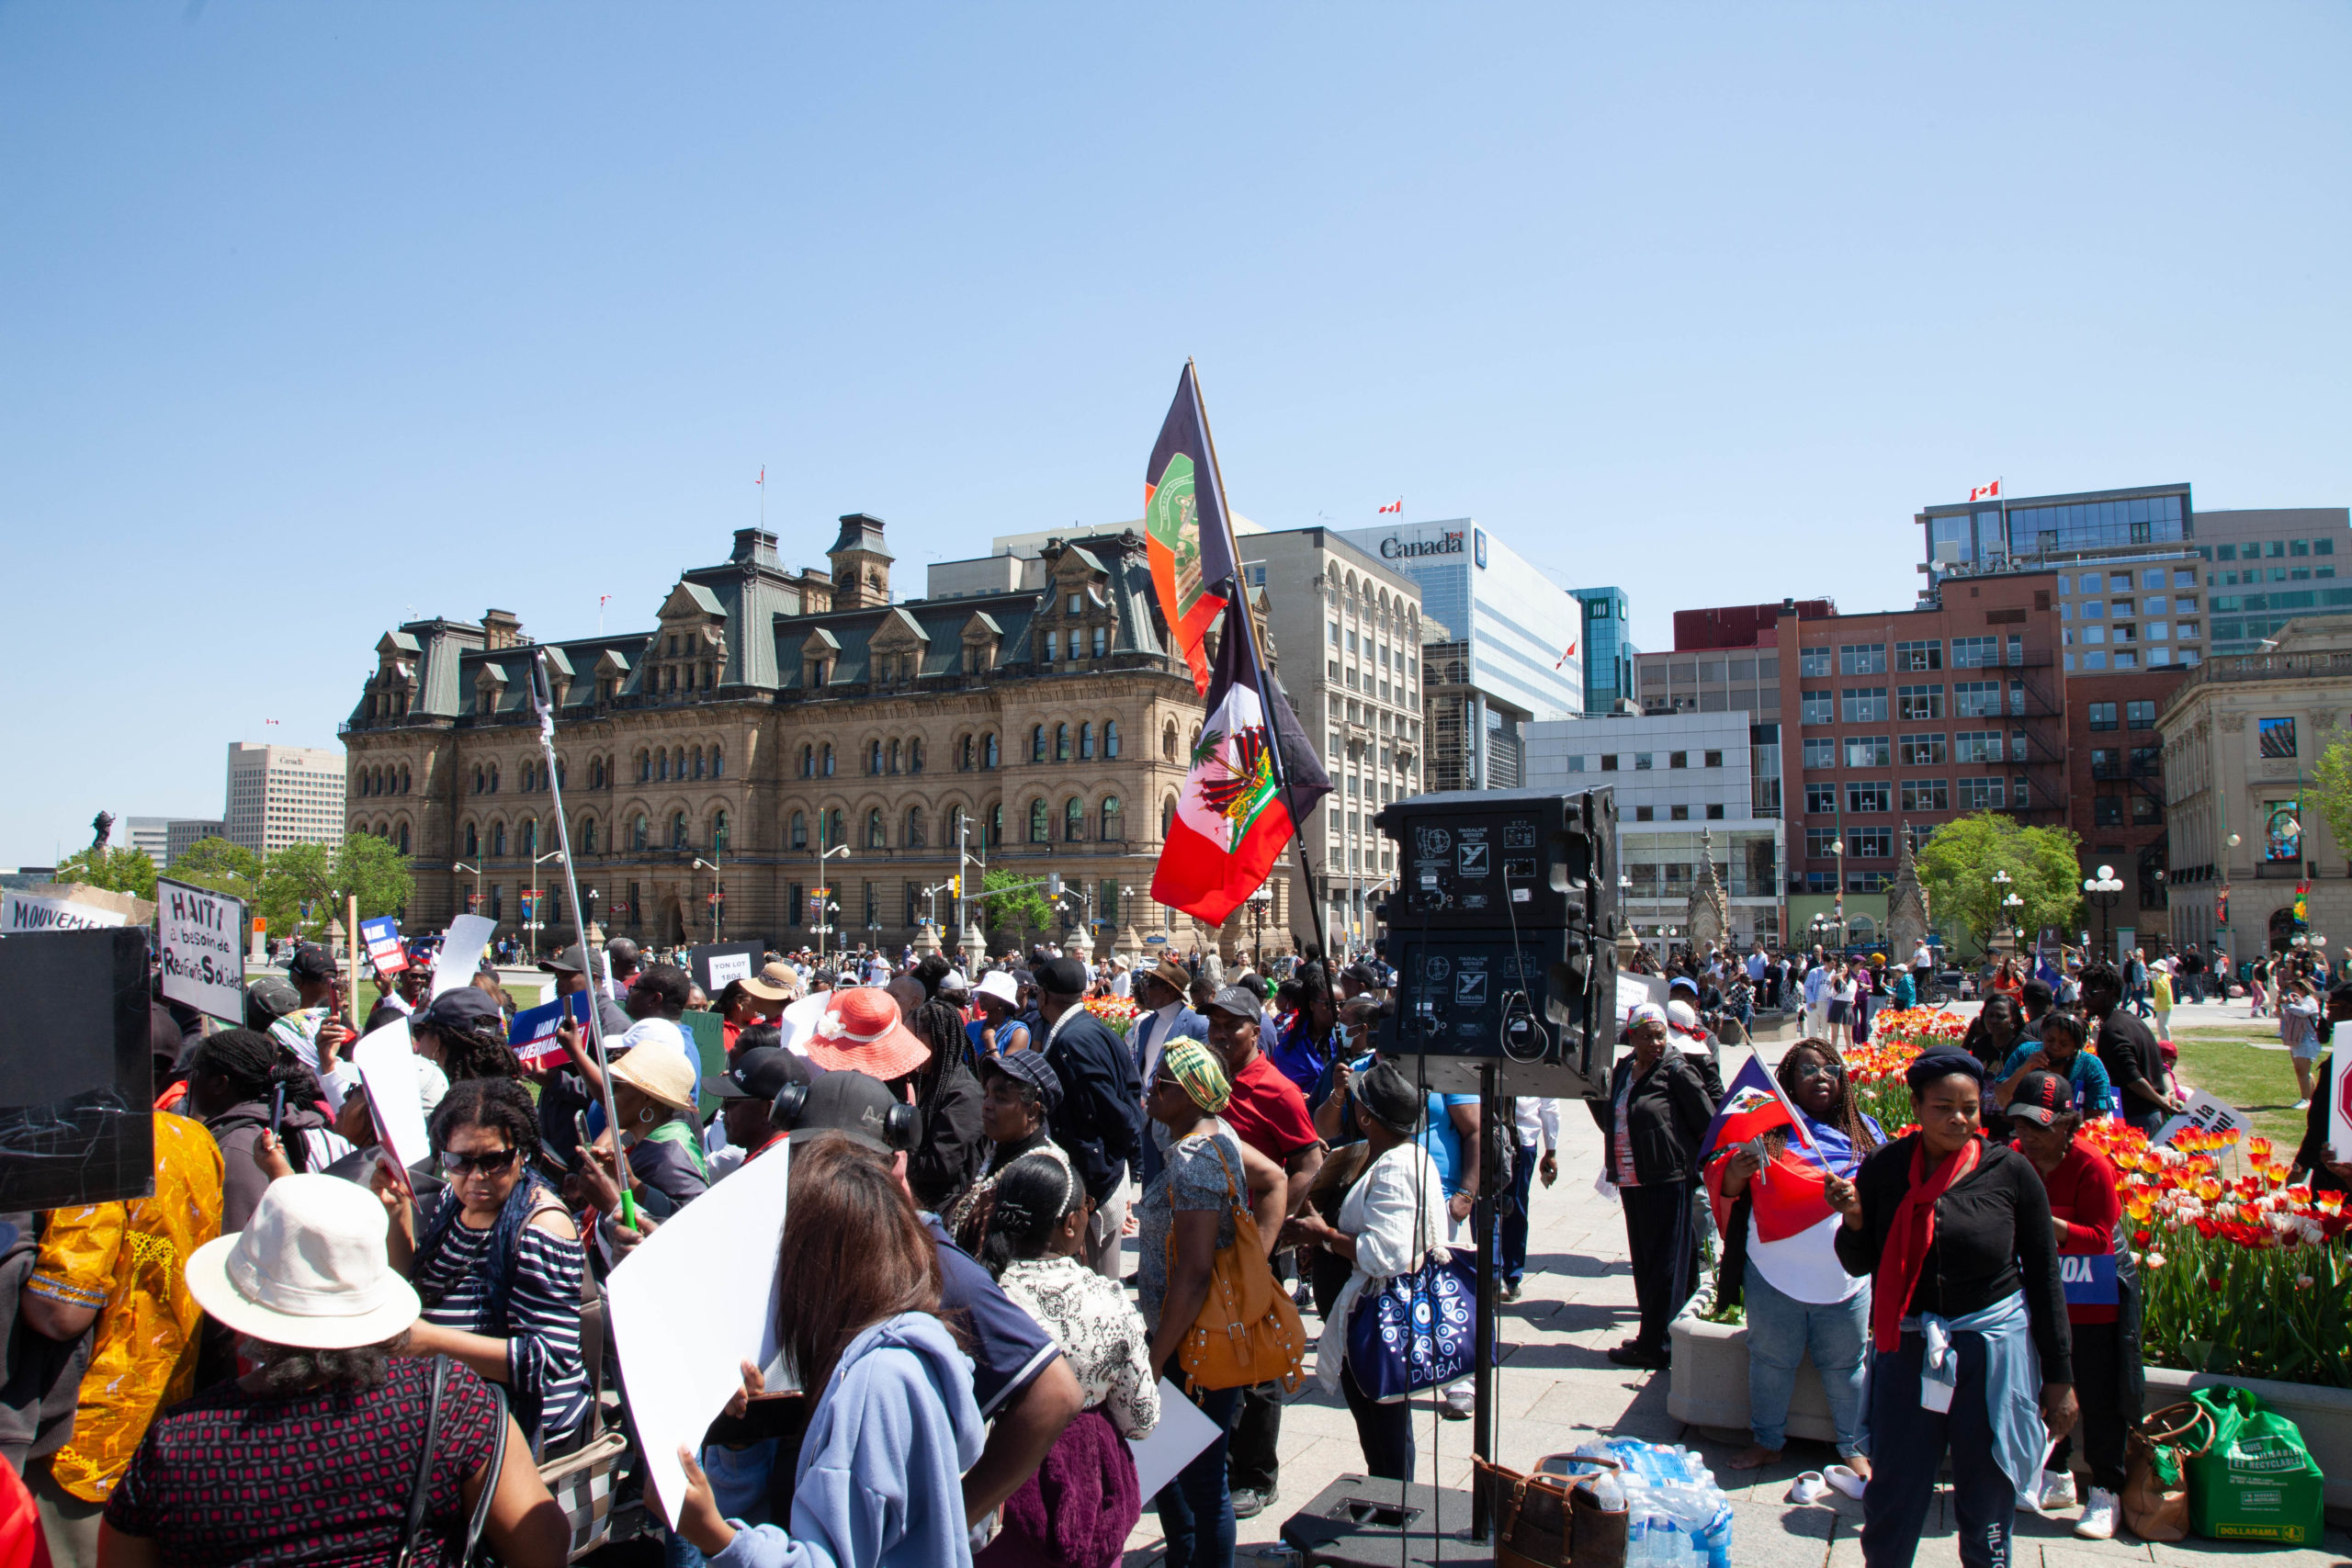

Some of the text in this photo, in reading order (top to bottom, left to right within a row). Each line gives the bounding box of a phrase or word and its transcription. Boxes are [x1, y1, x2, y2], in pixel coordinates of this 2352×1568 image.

[1380, 533, 1464, 558] Canada
[217, 939, 230, 953] de
[534, 1018, 556, 1039] NON
[2040, 1077, 2057, 1123] CANADA
[2195, 1103, 2216, 1121] la
[1411, 1356, 1463, 1383] DUBAI
[2234, 1456, 2301, 1469] ET RECYCLABLE
[2220, 1527, 2278, 1537] DOLLARAMA
